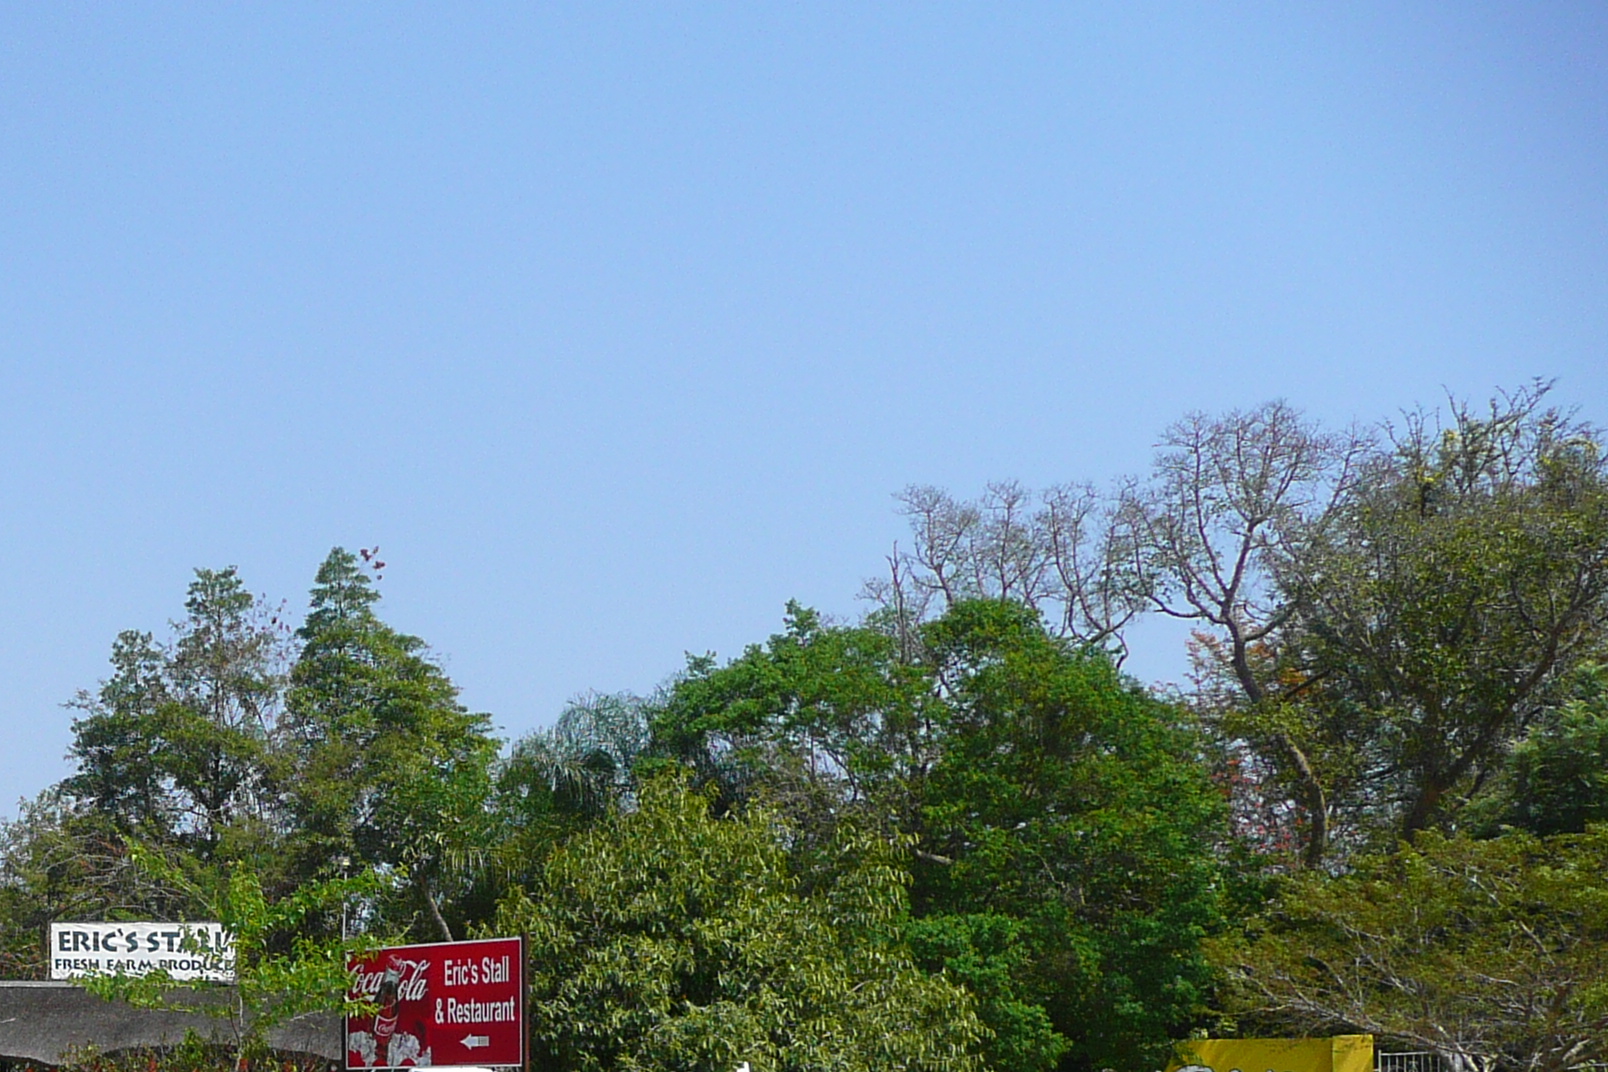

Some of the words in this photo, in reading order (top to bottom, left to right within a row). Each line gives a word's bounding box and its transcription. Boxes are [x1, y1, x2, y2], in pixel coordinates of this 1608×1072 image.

[58, 928, 139, 953] ERIC'S
[146, 931, 228, 952] STLL
[54, 958, 100, 970] FRESH
[106, 959, 152, 971] FARM
[444, 958, 479, 986] Eric's
[481, 955, 510, 983] Stall
[434, 998, 445, 1024] &
[447, 996, 516, 1024] Restaurant
